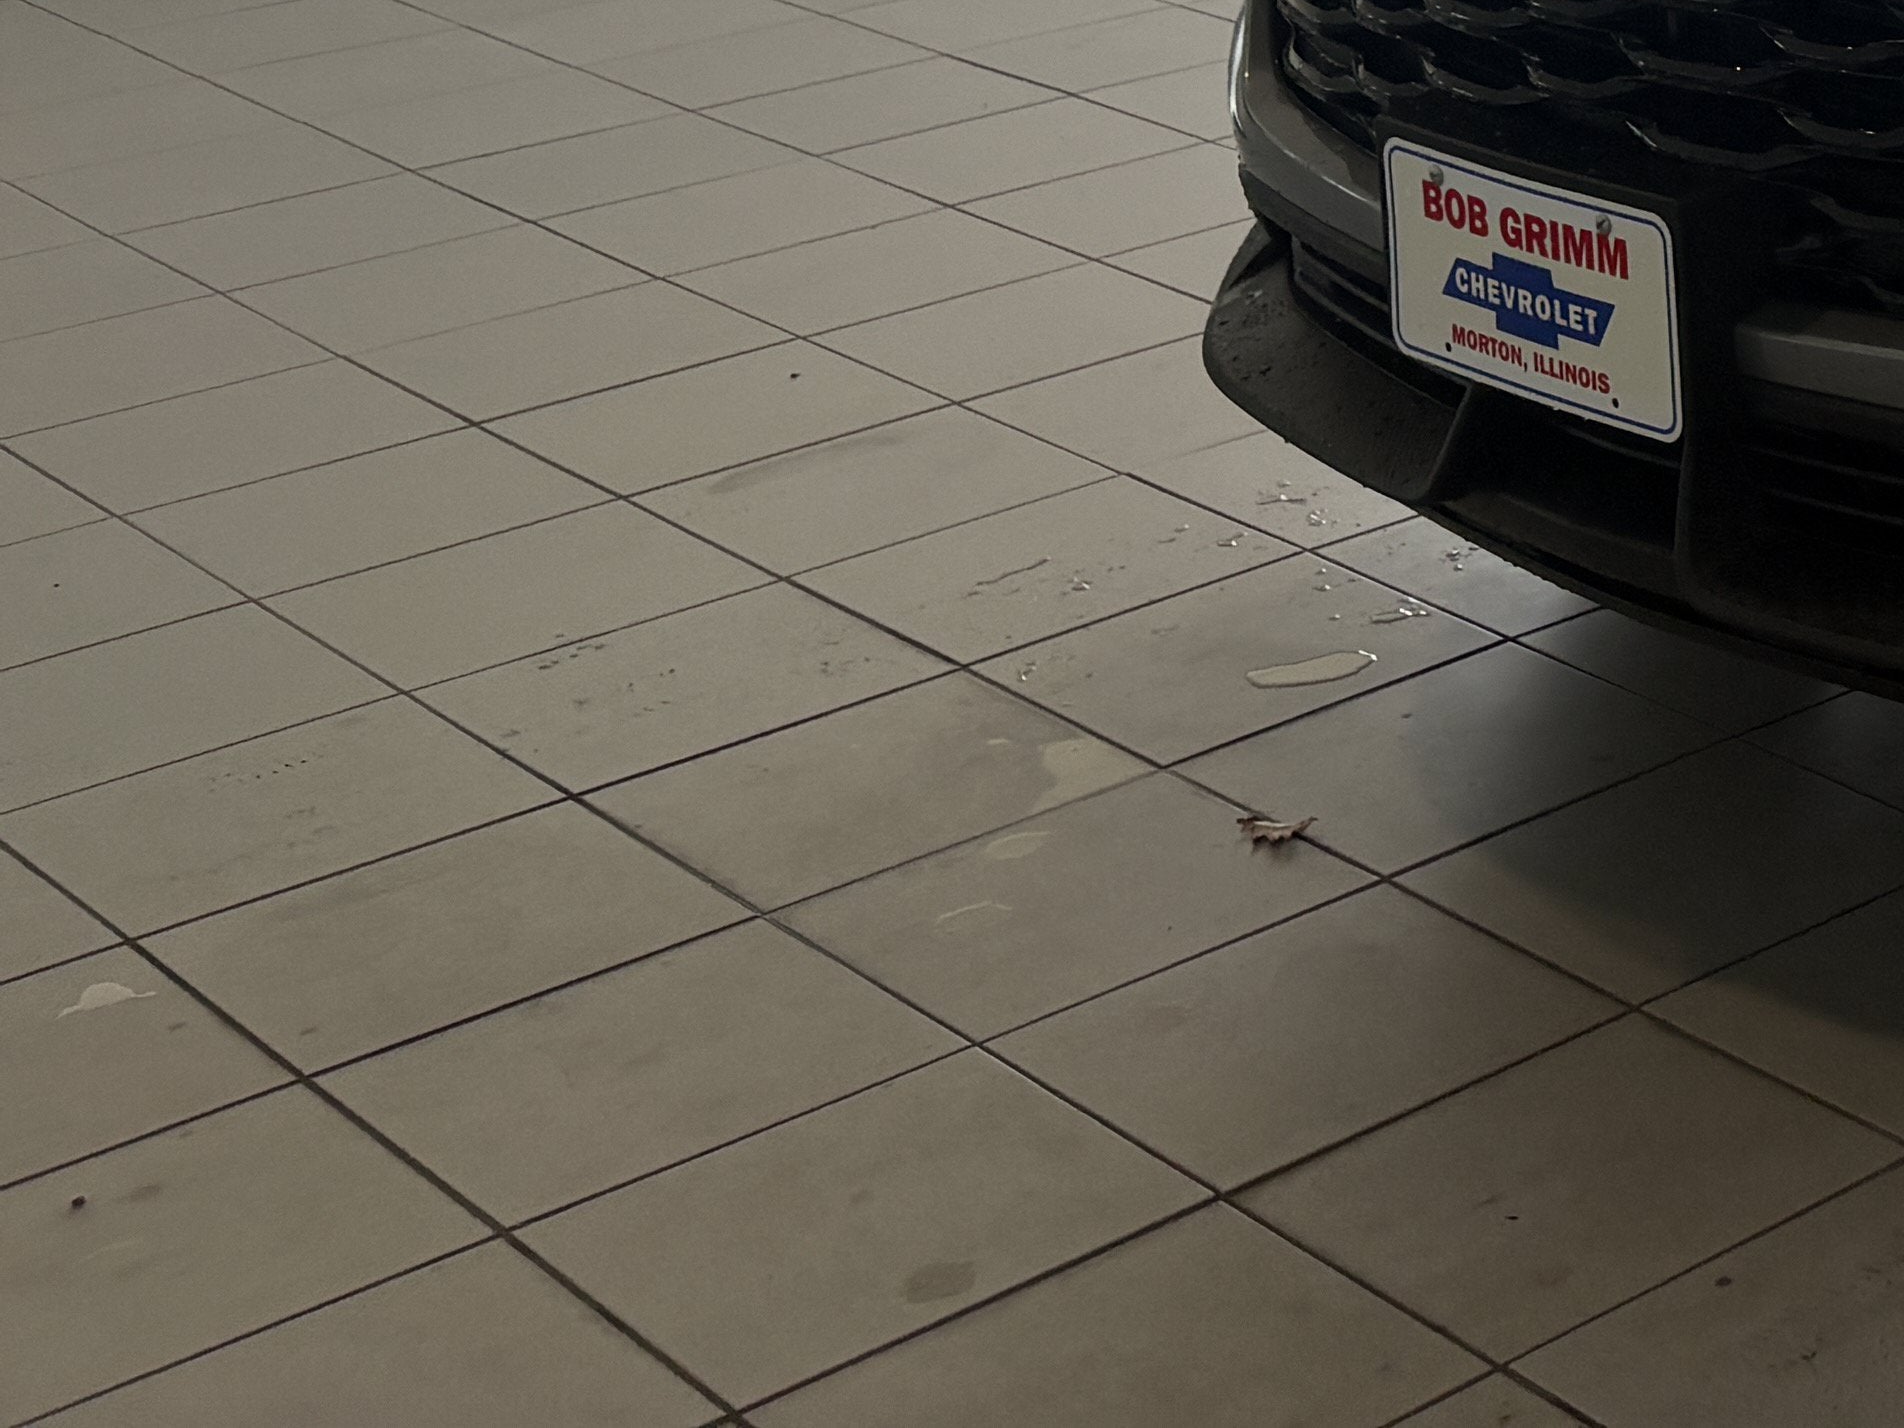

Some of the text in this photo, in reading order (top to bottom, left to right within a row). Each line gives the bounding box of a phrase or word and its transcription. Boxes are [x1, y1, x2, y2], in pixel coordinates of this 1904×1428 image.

[1422, 179, 1630, 280] BOB GRIMM
[1455, 266, 1599, 336] CHEVROLET
[1451, 323, 1611, 395] MORTON, ILLINOIS
